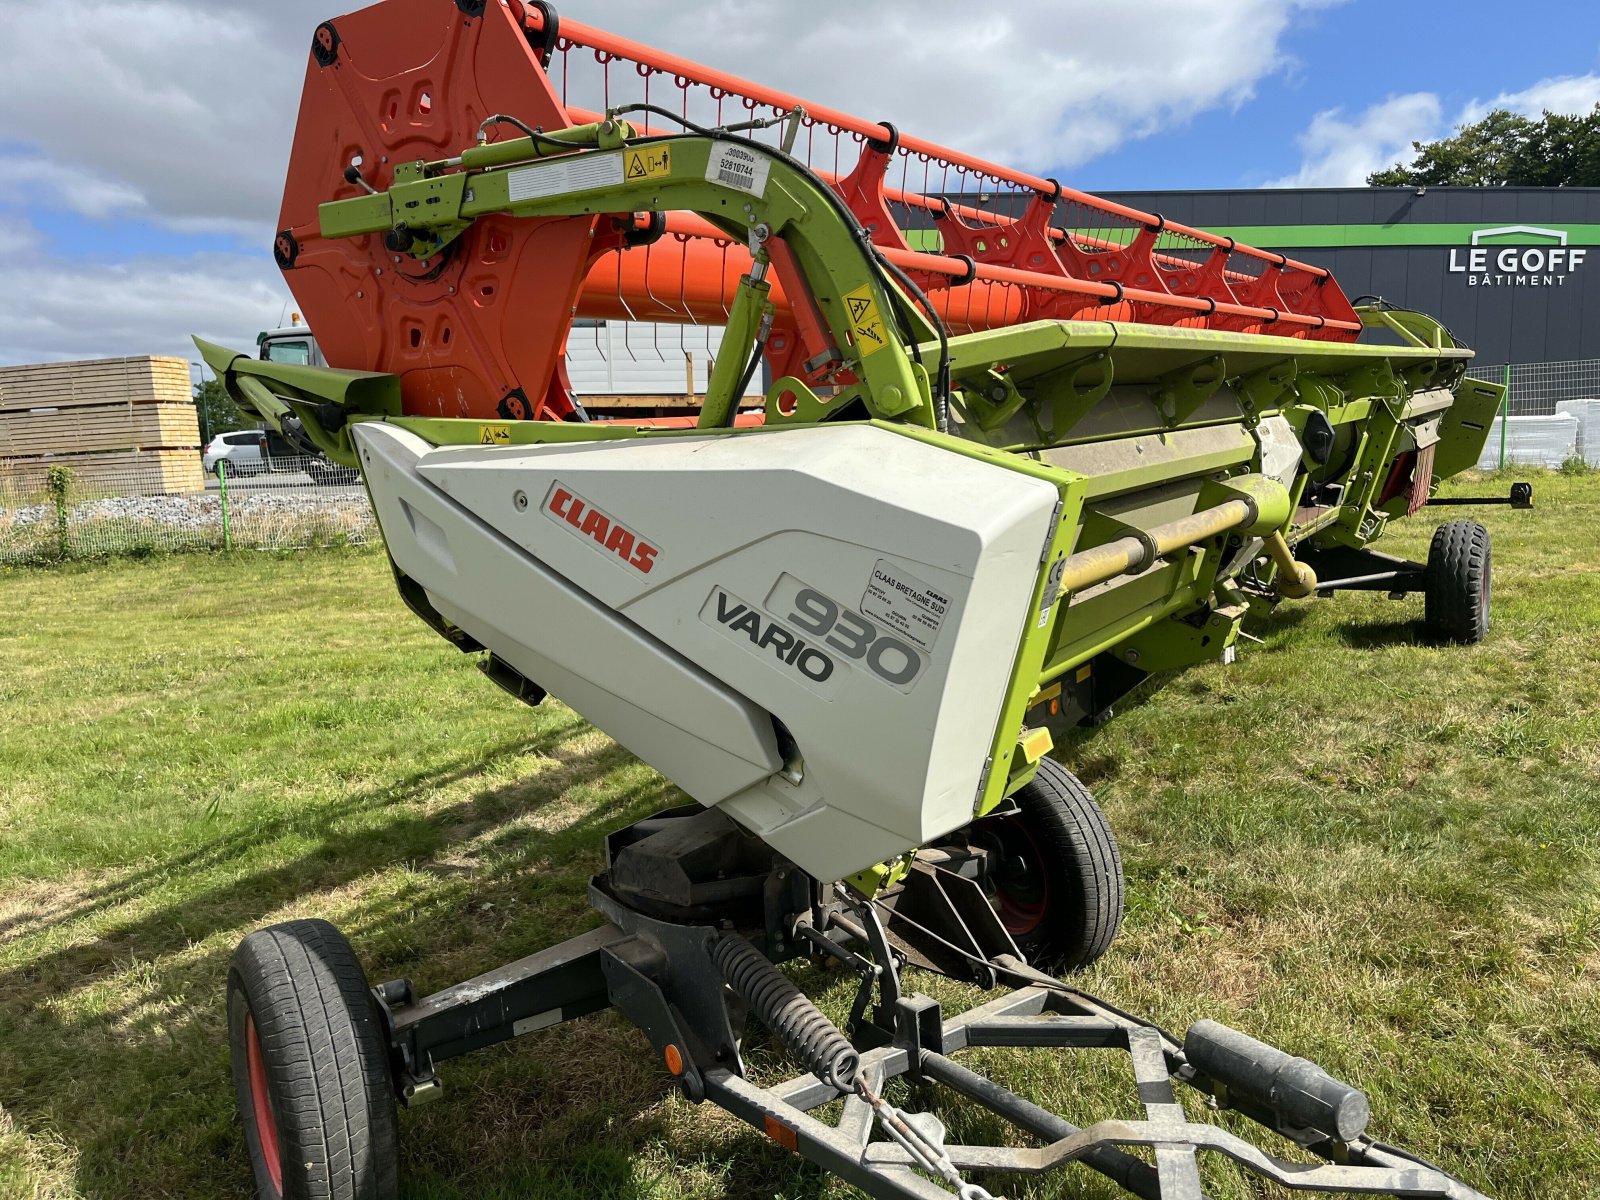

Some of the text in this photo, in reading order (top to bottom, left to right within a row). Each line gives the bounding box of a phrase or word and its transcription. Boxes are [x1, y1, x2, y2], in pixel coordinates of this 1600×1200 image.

[720, 159, 753, 176] 52810744
[1450, 248, 1586, 272] LE GOFF
[1468, 273, 1565, 286] BÂTIMENT
[549, 488, 658, 574] CLAAS
[875, 570, 896, 587] CLAAS
[896, 582, 931, 607] BRETAGNE
[930, 602, 944, 614] SUD
[926, 590, 948, 604] CLAAS
[717, 591, 834, 682] VARIO
[787, 589, 921, 685] 930
